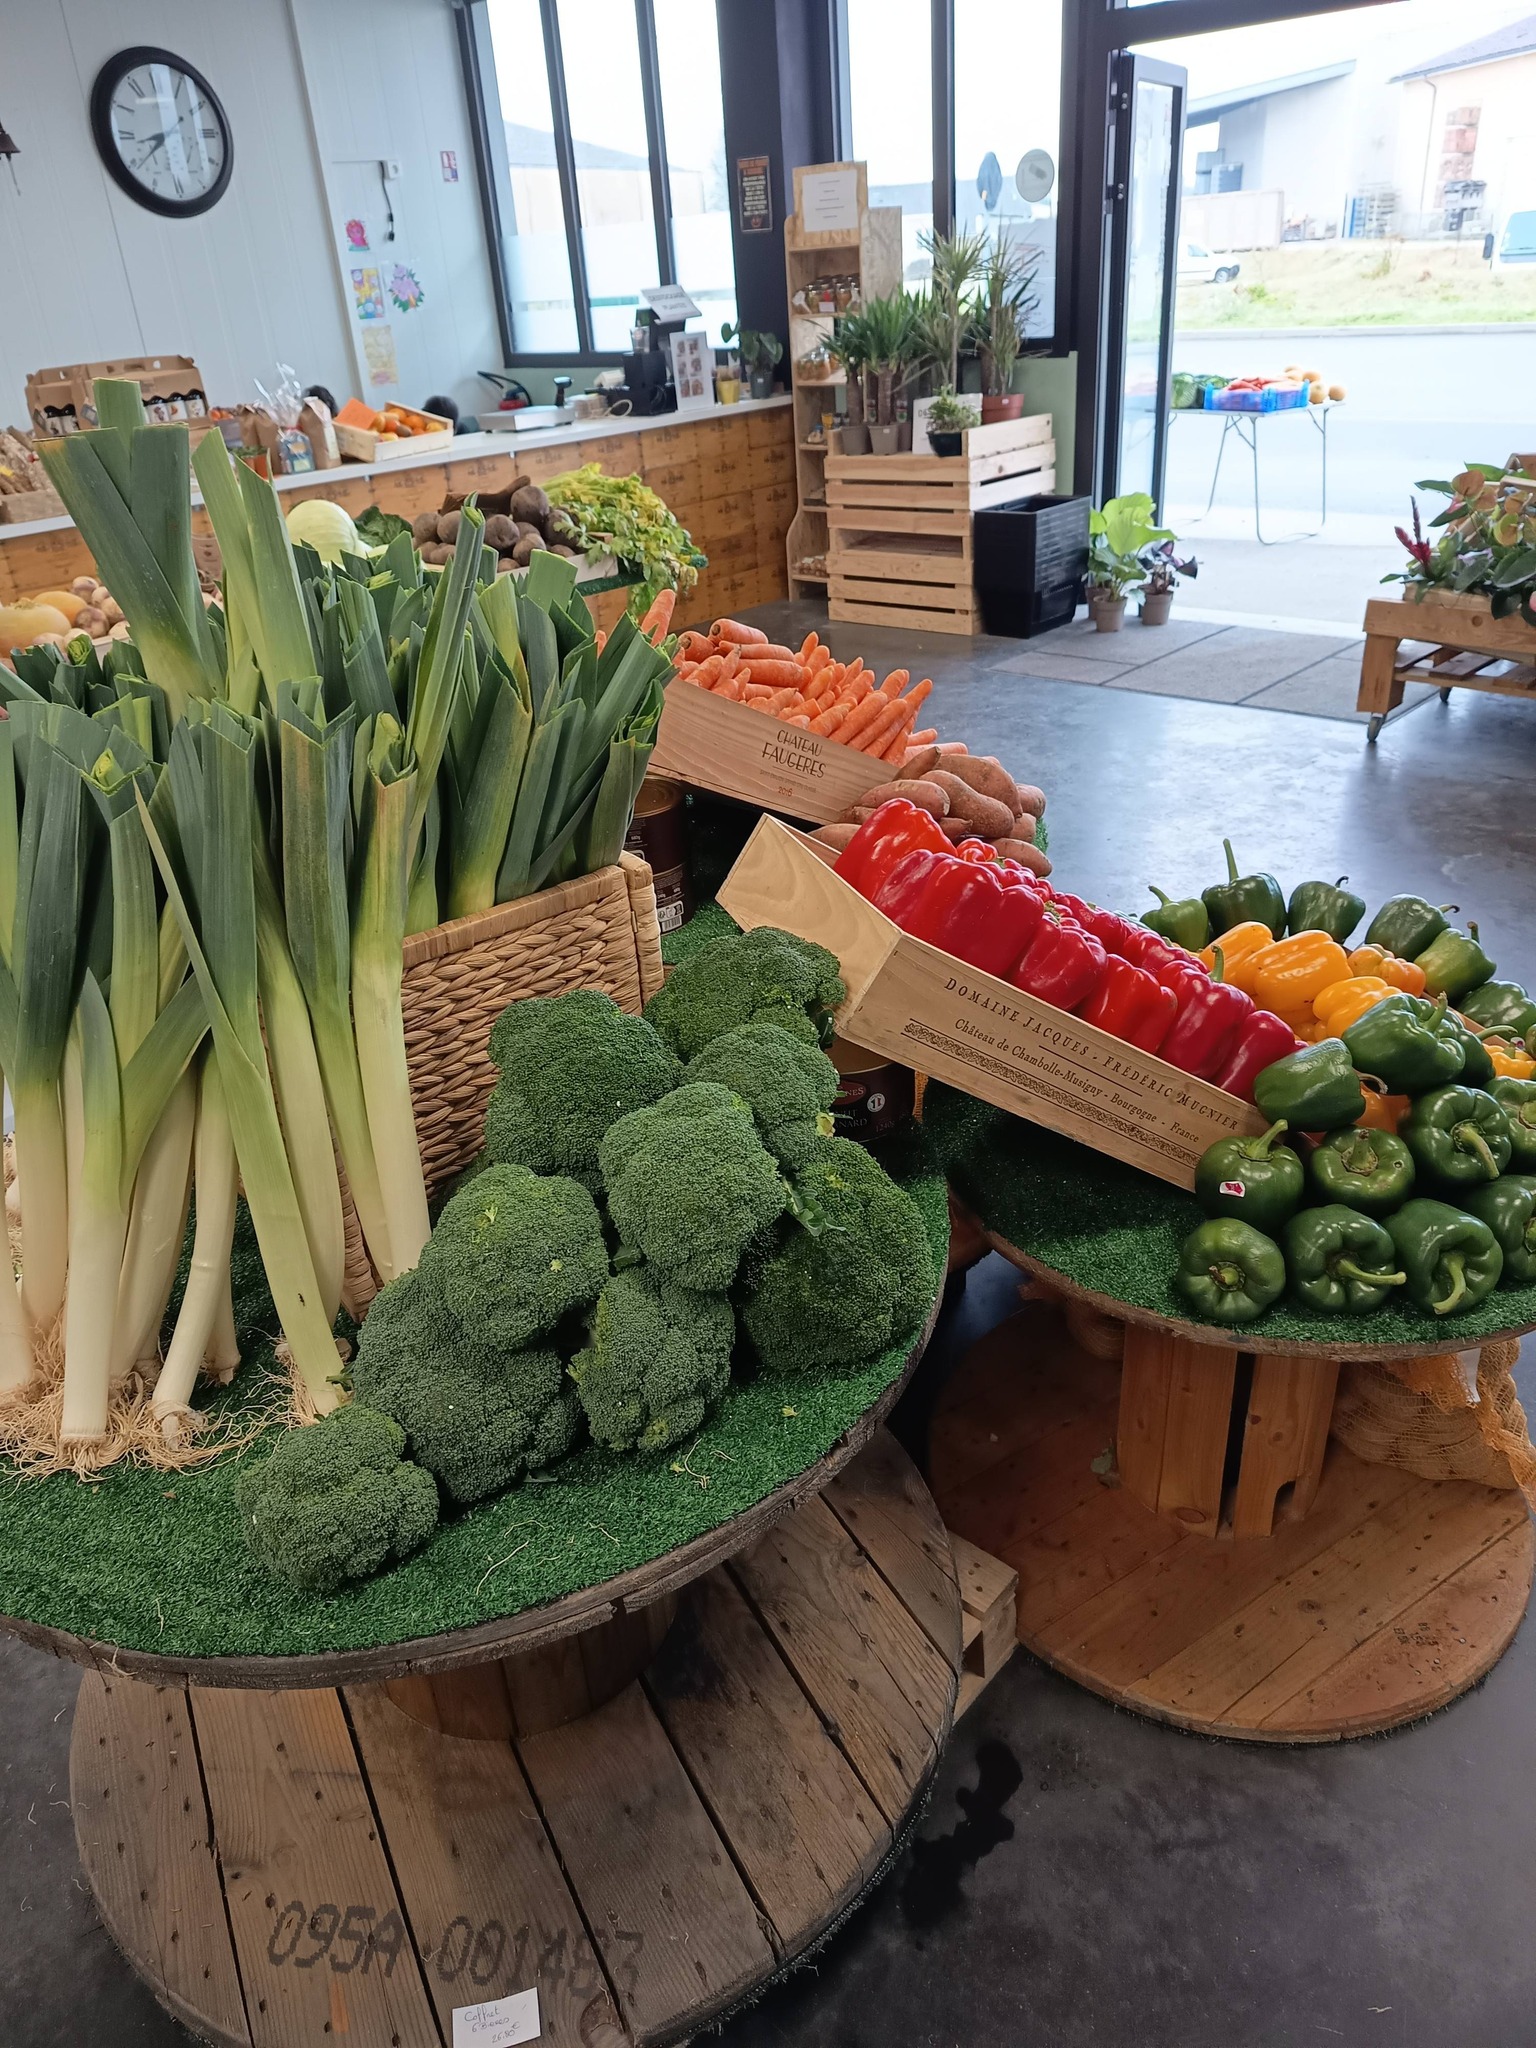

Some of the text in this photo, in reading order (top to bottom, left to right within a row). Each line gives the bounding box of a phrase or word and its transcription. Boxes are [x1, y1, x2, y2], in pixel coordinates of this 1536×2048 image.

[762, 742, 827, 779] FAUGERES
[777, 729, 823, 757] CHATEAU
[944, 977, 1019, 1022] DOMAINE
[1023, 1016, 1089, 1055] JACQUES
[1103, 1055, 1172, 1098] FRÉDÉRIC
[1176, 1091, 1238, 1131] MUGNIER
[955, 1018, 995, 1046] Château
[997, 1037, 1009, 1052] de
[1011, 1044, 1103, 1097] Chambolle-Musigny
[1110, 1092, 1158, 1124] Bourgogne
[1170, 1121, 1200, 1143] France
[267, 1900, 404, 1978] 095A
[464, 2004, 500, 2023] Coffret
